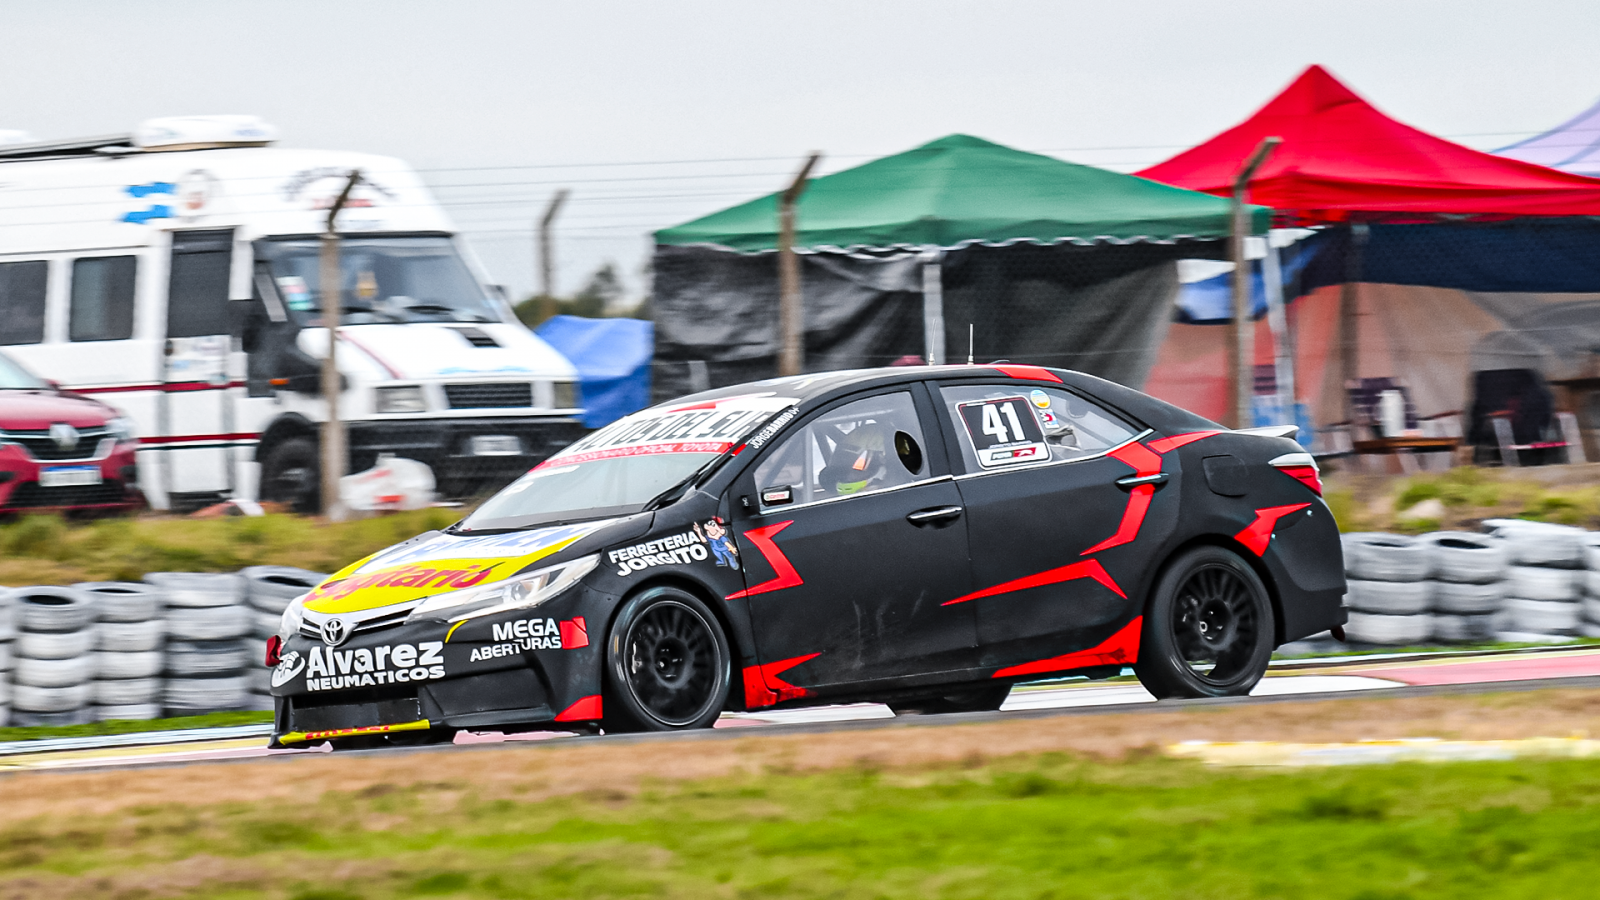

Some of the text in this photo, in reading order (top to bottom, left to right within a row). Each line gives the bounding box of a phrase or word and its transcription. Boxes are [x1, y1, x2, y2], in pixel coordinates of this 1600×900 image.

[645, 411, 720, 441] DEL
[694, 410, 777, 439] SUR
[982, 401, 1026, 443] 41
[677, 443, 722, 452] TOYOTA
[608, 531, 701, 563] FERRETERIA
[617, 544, 708, 576] JORGITO
[492, 617, 560, 642] MEGA
[306, 641, 444, 679] Alvarez
[469, 636, 562, 662] ABERTURAS
[306, 665, 446, 691] NEUMATICOS
